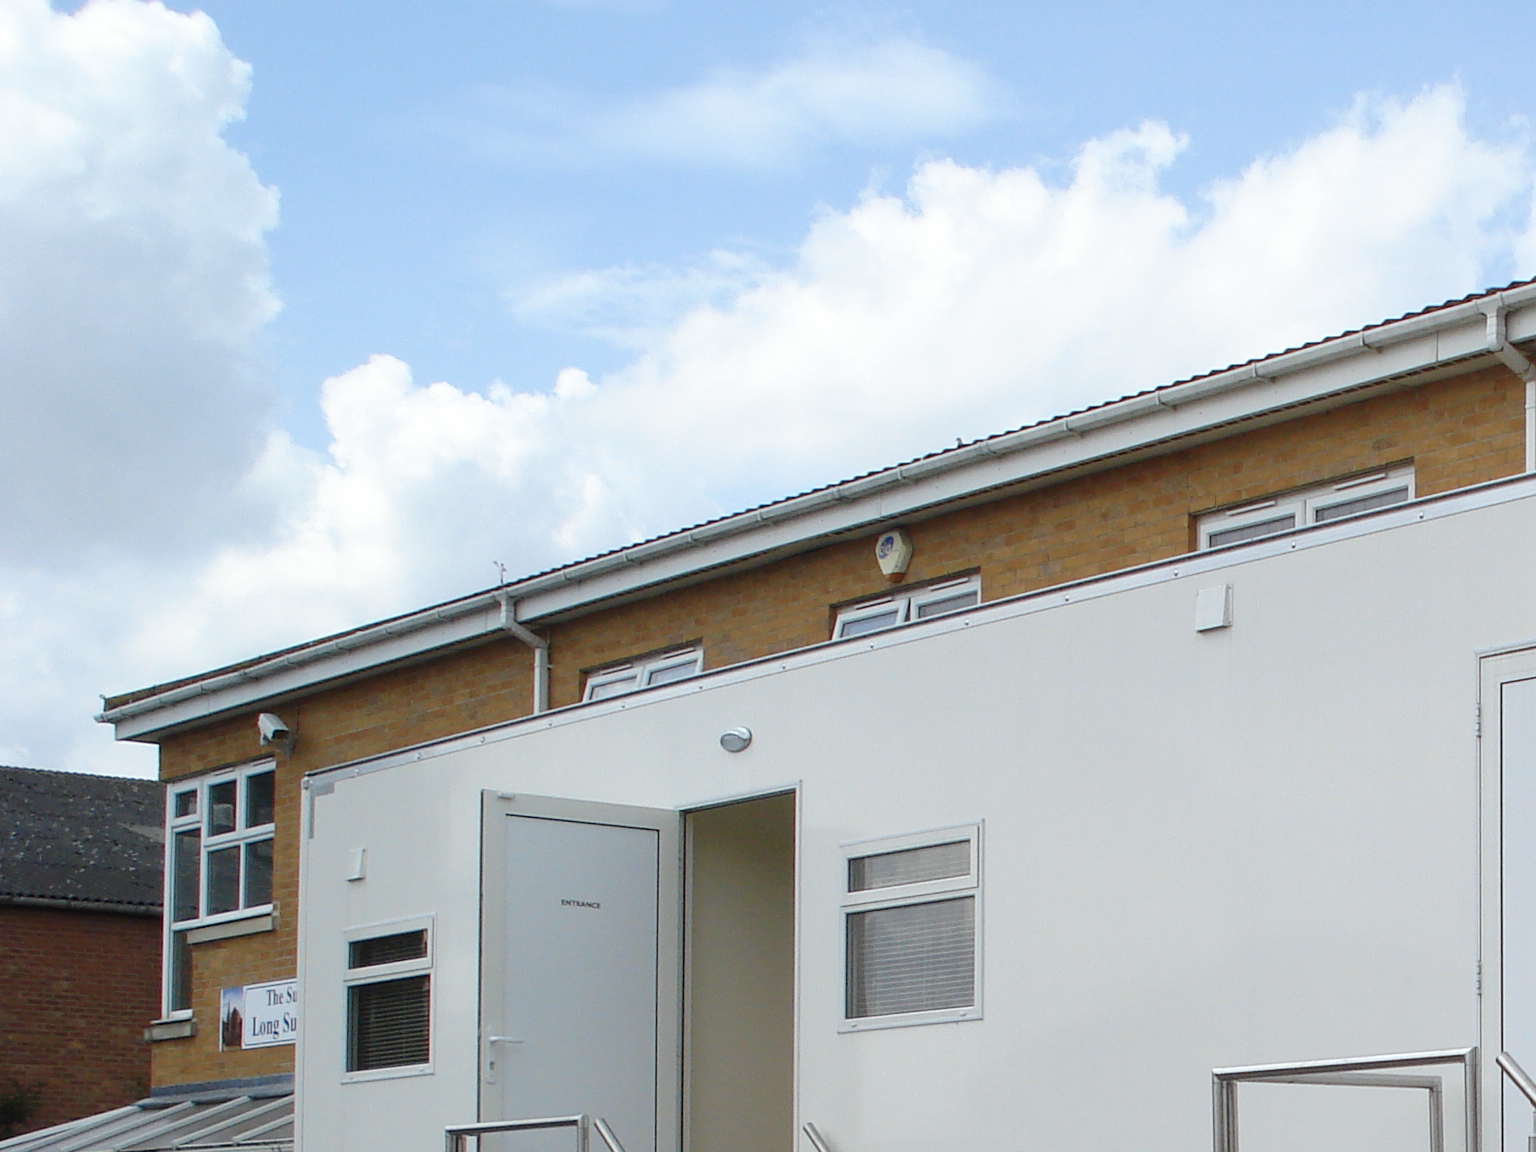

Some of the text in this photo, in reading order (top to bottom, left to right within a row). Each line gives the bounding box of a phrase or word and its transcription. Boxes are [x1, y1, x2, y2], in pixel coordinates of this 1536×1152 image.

[561, 899, 600, 909] ENTRANCE
[266, 986, 298, 1006] The Su
[253, 1012, 297, 1040] Long Su
